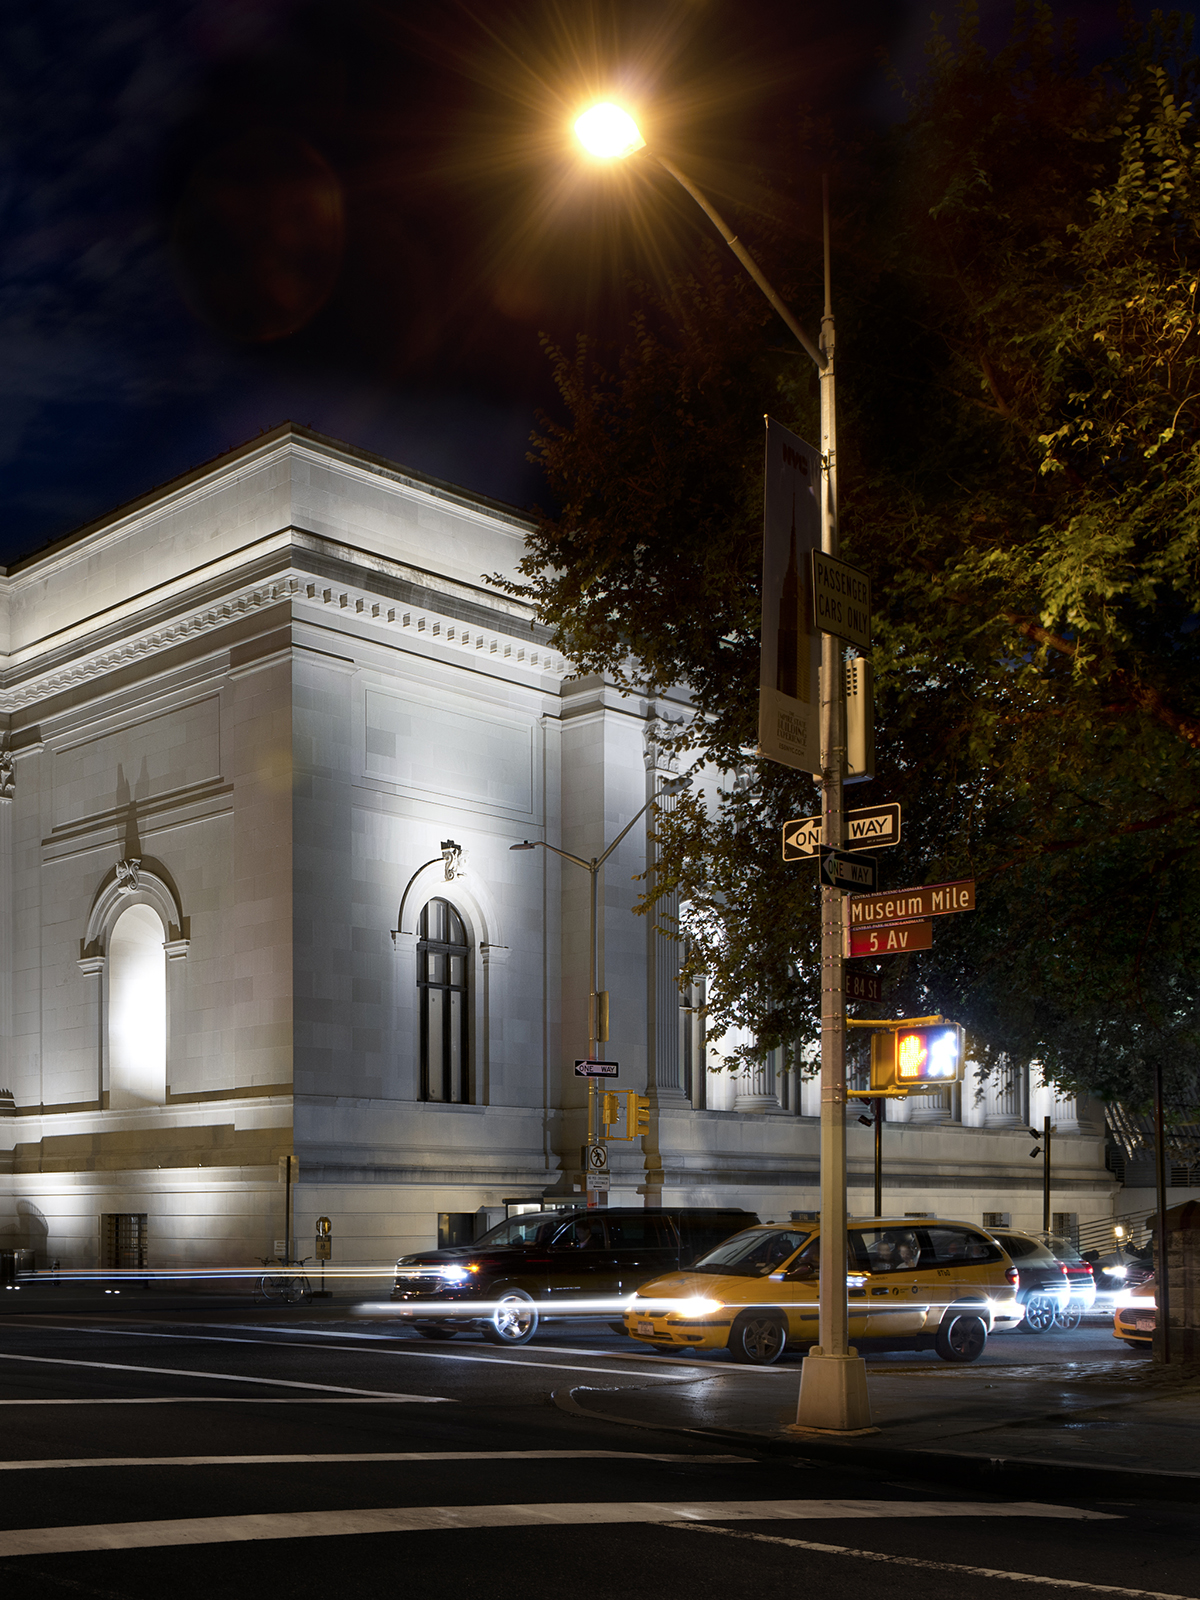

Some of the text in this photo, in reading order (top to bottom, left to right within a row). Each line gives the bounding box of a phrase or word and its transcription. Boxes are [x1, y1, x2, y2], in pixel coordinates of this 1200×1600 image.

[783, 442, 808, 476] NYC
[818, 562, 867, 605] PASSENGER
[819, 594, 867, 634] CARS ONLY
[777, 718, 807, 738] BUILDING
[795, 817, 889, 846] ON WAY
[828, 859, 870, 883] ONE WAY
[851, 887, 970, 923] Museum Mile
[870, 930, 909, 952] 5 Av
[845, 975, 878, 999] E 84 St
[579, 1065, 594, 1073] ONE
